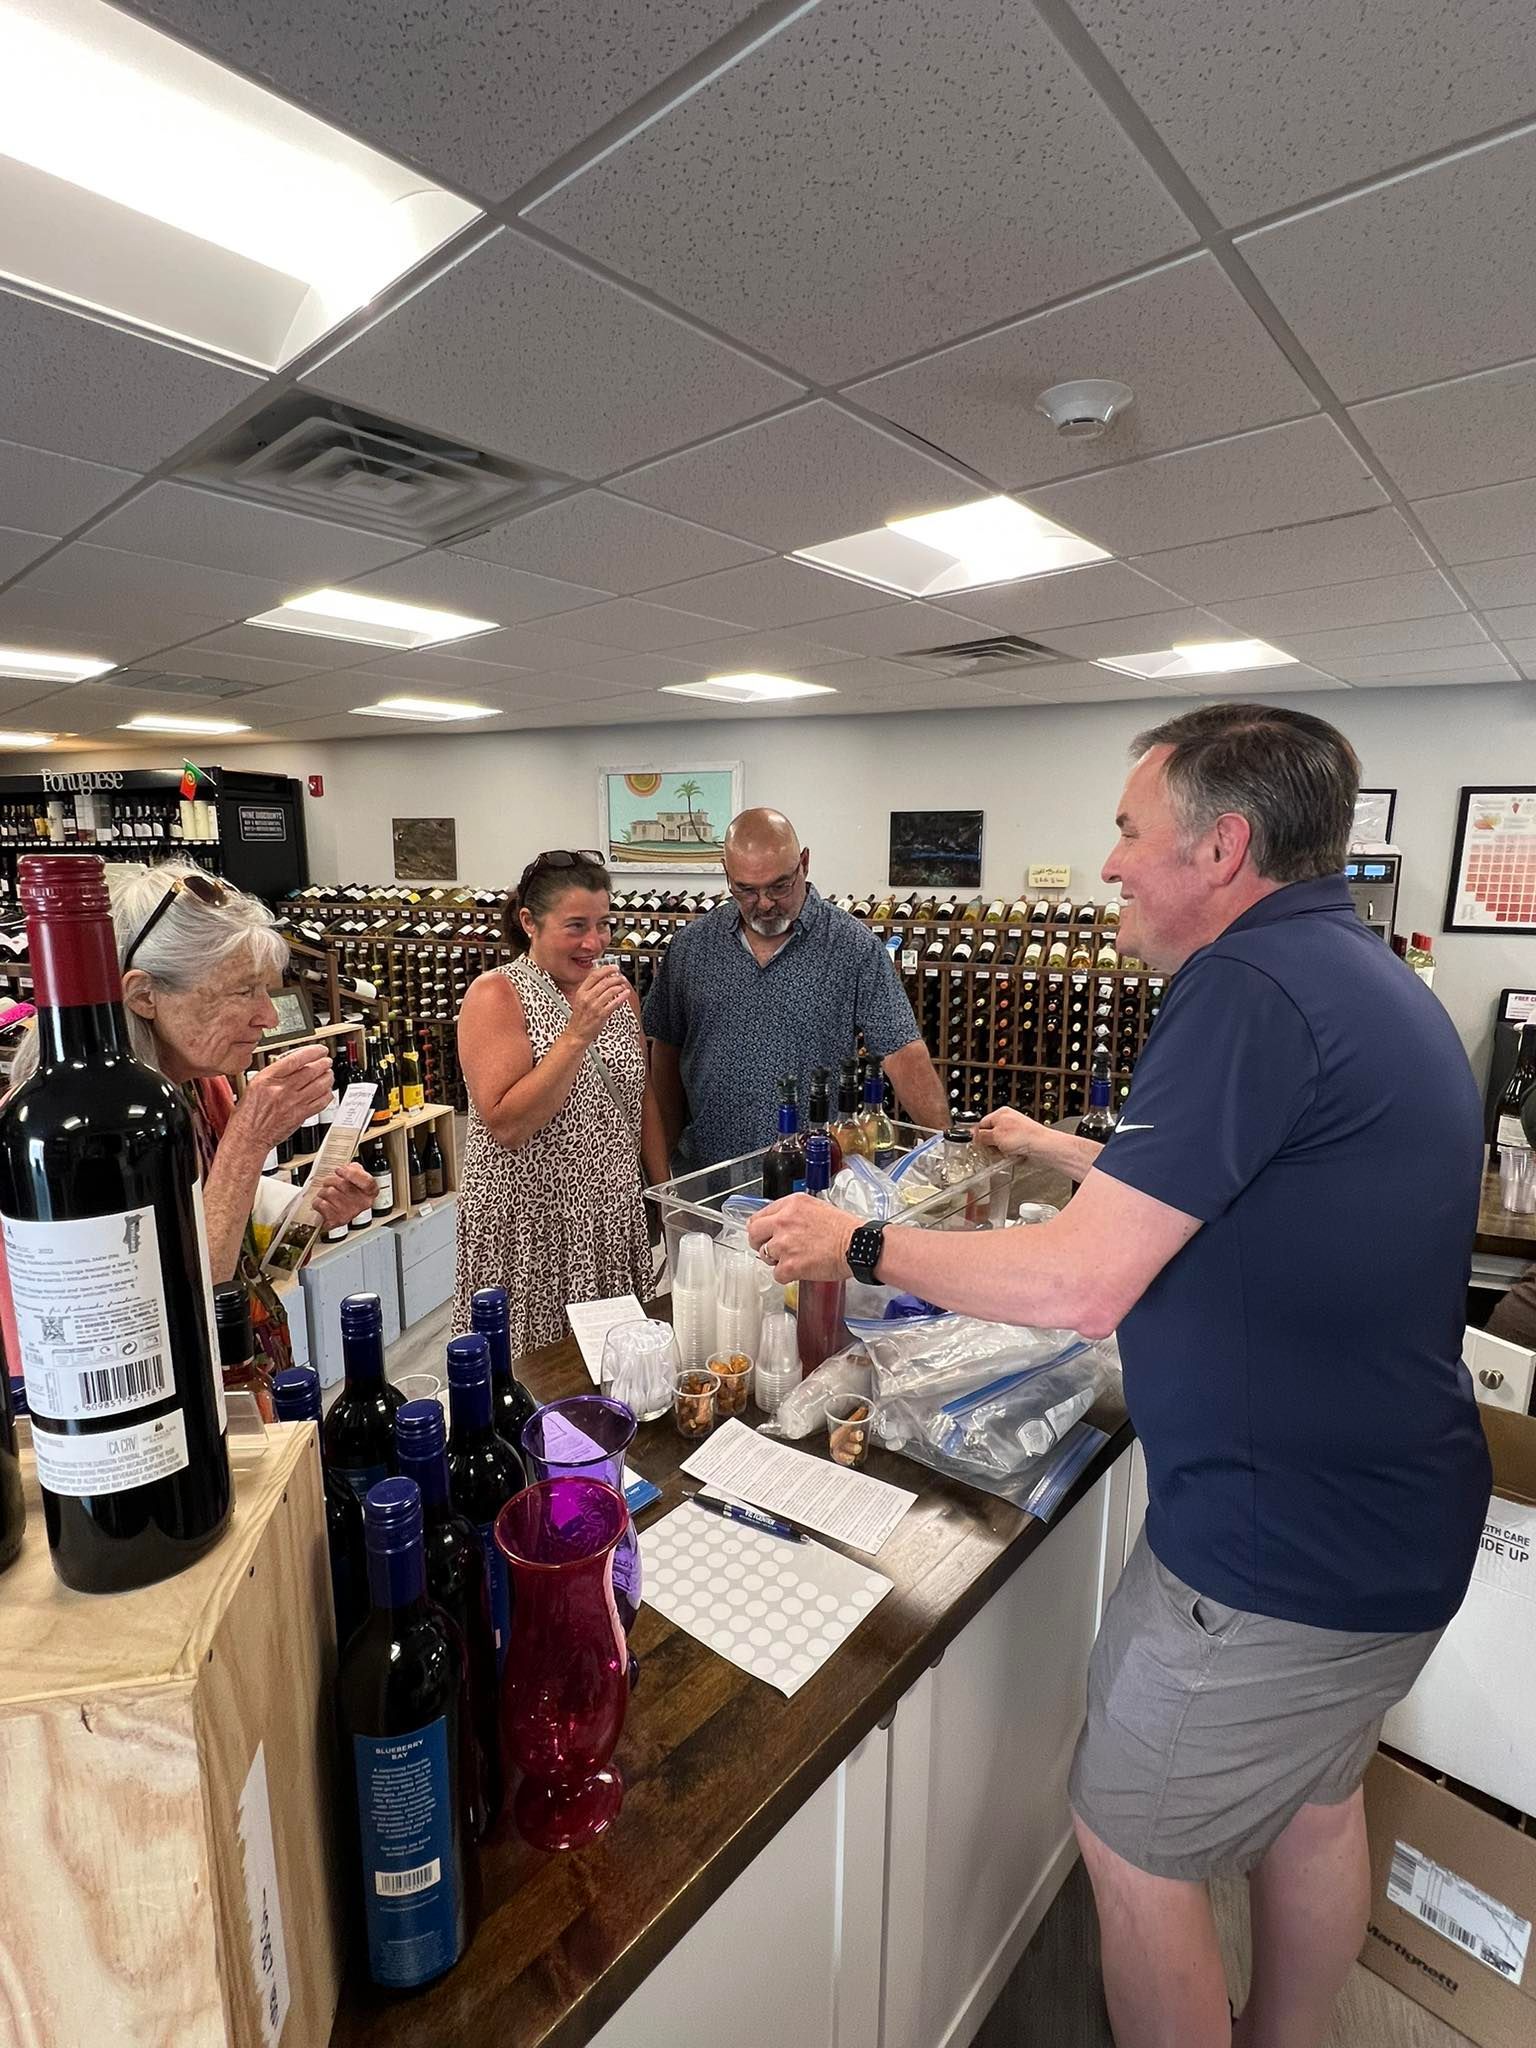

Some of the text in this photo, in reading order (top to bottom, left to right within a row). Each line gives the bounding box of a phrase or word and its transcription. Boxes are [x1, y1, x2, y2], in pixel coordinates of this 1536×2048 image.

[41, 768, 124, 797] Portuguese
[109, 1436, 137, 1455] CA CRV
[1503, 1529, 1531, 1547] CARE
[1480, 1536, 1530, 1563] IDE UP
[375, 1739, 425, 1755] BLUEBERRY
[391, 1752, 409, 1760] BAY
